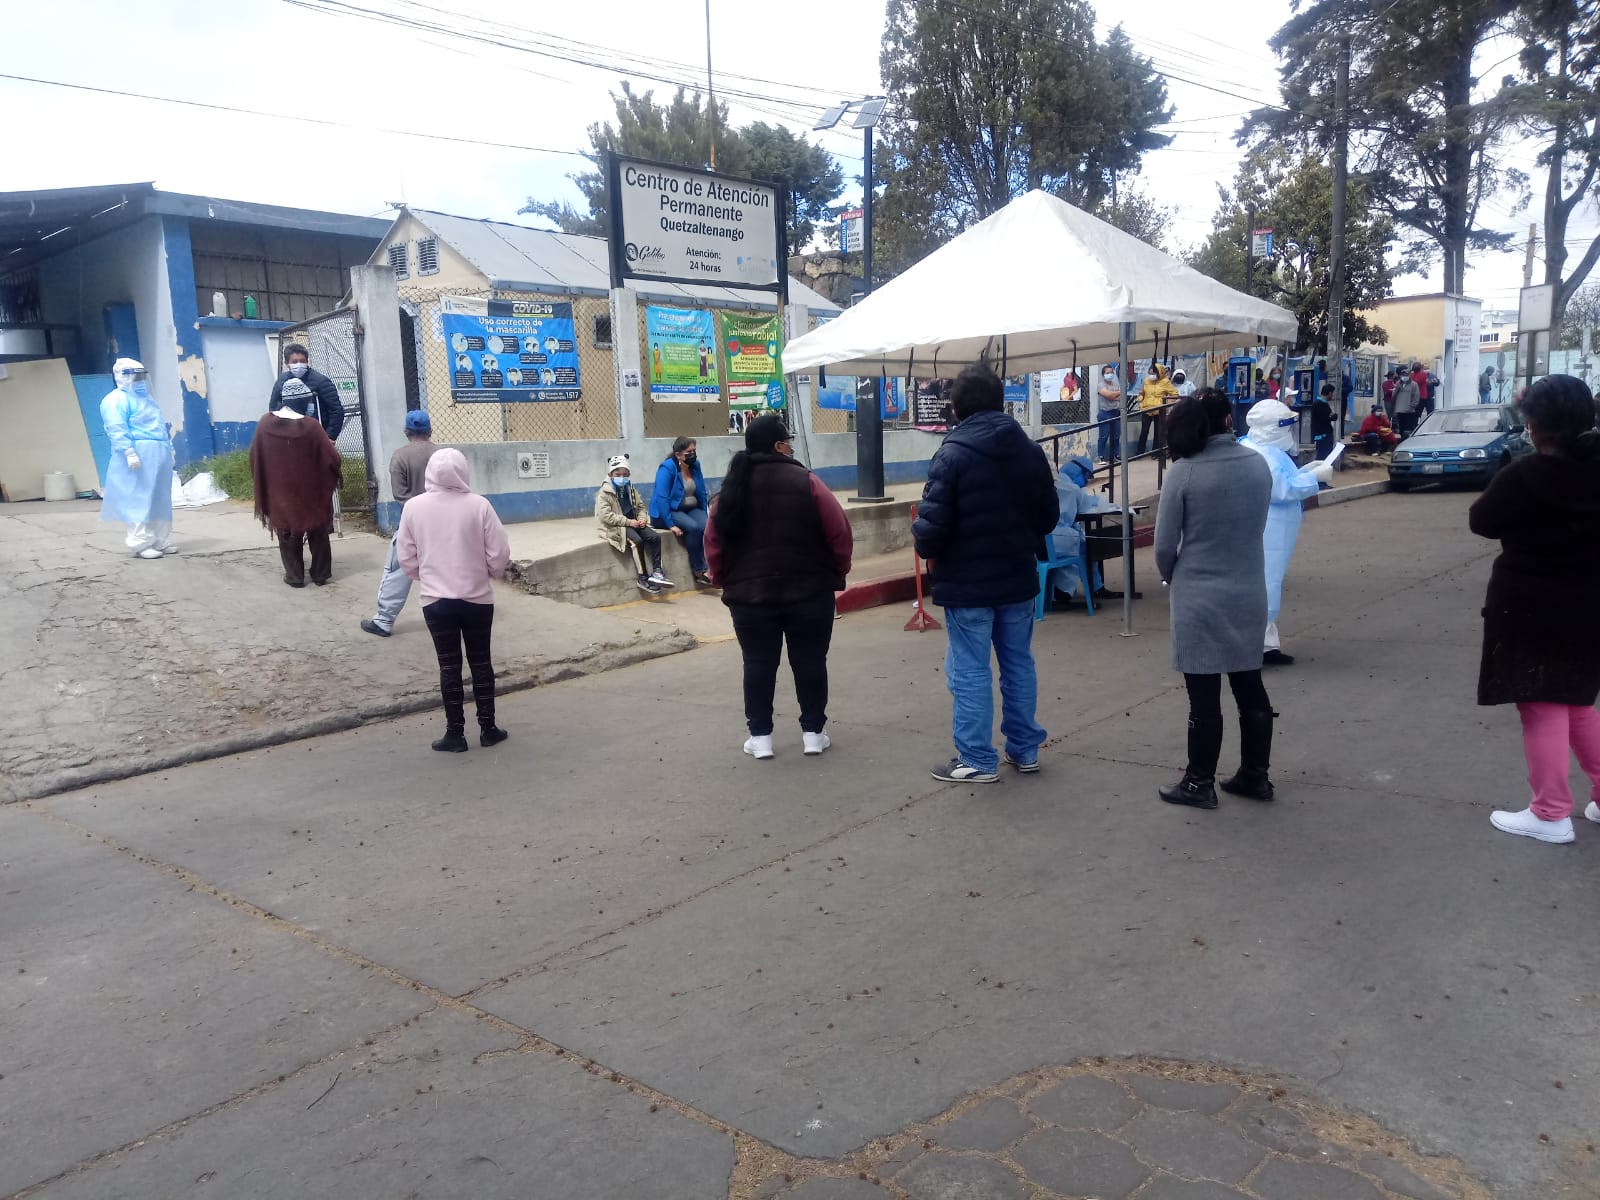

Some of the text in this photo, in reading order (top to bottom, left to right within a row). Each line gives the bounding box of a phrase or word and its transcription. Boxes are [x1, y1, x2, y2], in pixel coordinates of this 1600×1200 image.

[625, 167, 769, 207] Centro de Atención
[660, 195, 743, 222] Permanente
[660, 217, 744, 241] Quetzaltenango
[686, 247, 721, 260] Atención:
[689, 260, 721, 272] 24 horas
[512, 303, 553, 314] COVID-19
[478, 317, 543, 326] Uso correcto de
[486, 325, 538, 334] la mascarilla
[565, 391, 579, 399] 1517
